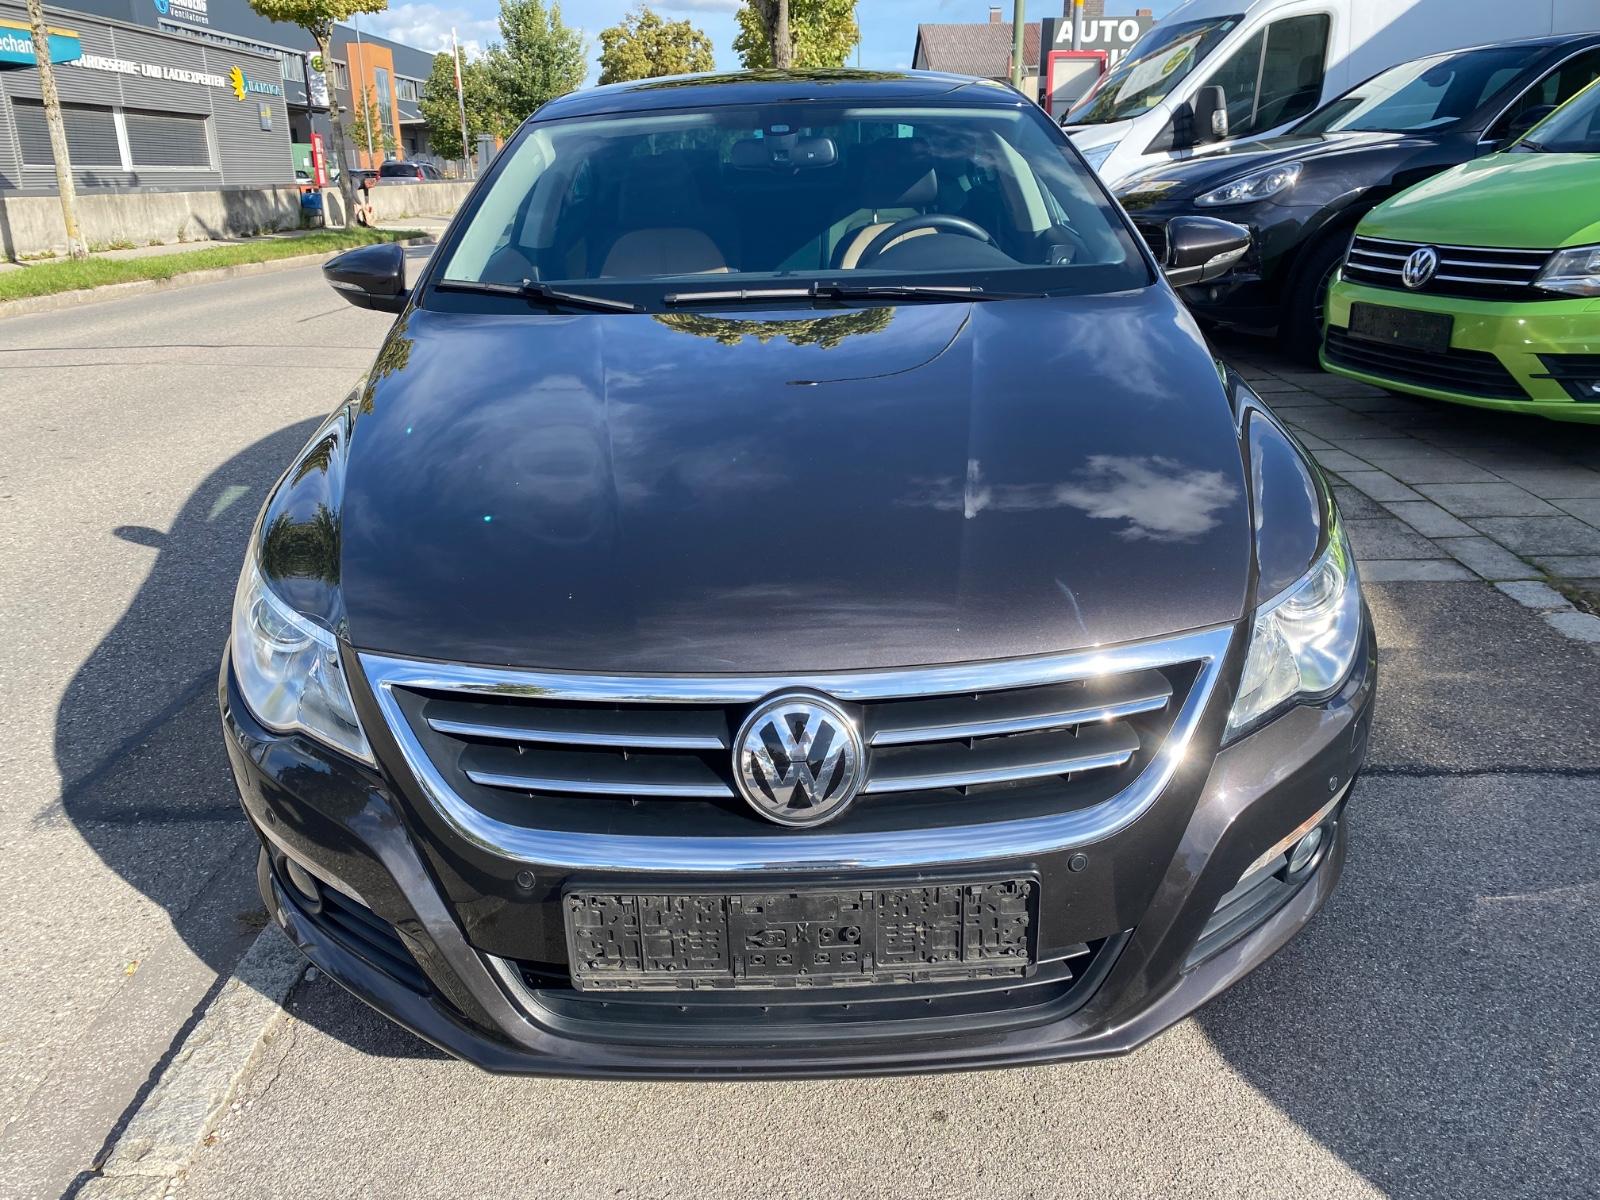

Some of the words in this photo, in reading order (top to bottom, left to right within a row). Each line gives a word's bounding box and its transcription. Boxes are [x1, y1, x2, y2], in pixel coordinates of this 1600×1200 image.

[169, 7, 209, 24] Ventilatoren
[1055, 20, 1140, 43] AUTO
[141, 64, 162, 79] UND
[163, 67, 226, 87] LACKEXPERTEN
[738, 700, 858, 820] VW
